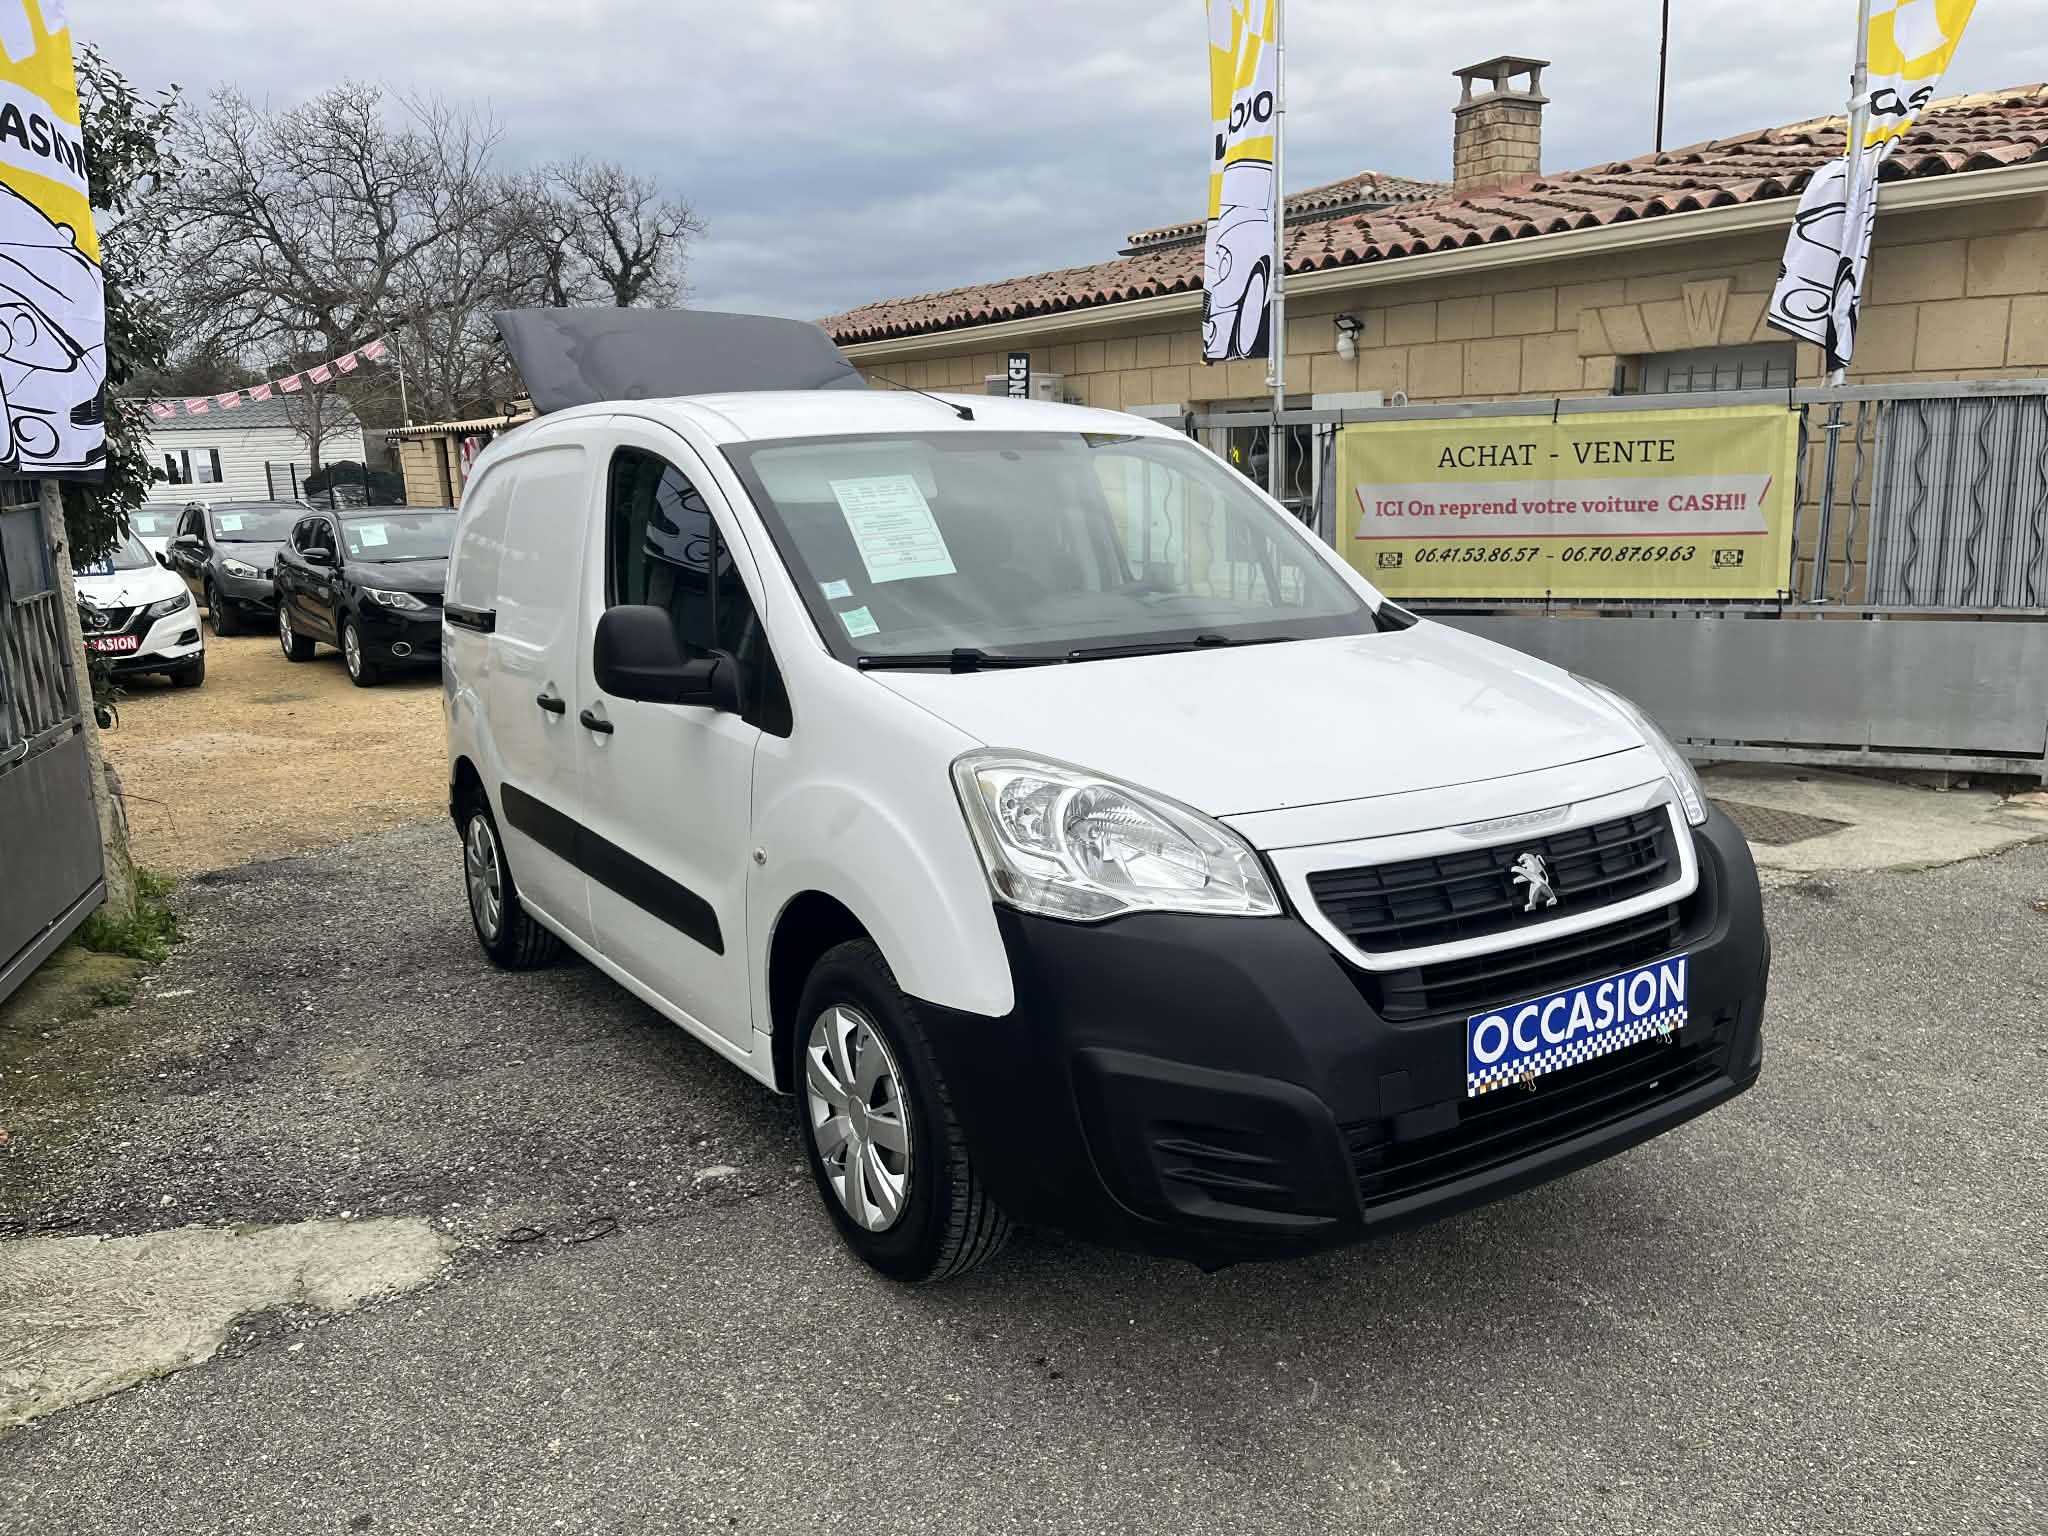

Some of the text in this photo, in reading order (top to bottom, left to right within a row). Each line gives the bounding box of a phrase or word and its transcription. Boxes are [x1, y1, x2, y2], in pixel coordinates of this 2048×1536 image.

[1438, 444, 1537, 468] ACHAT
[1572, 439, 1675, 464] VENTE
[1375, 494, 1746, 520] ICI On reprend votre voiture CASH!!
[1414, 548, 1540, 563] 06.41.53.86.57
[1561, 546, 1696, 562] 06.70.87.69.63
[1473, 959, 1686, 1064] OCCASION
